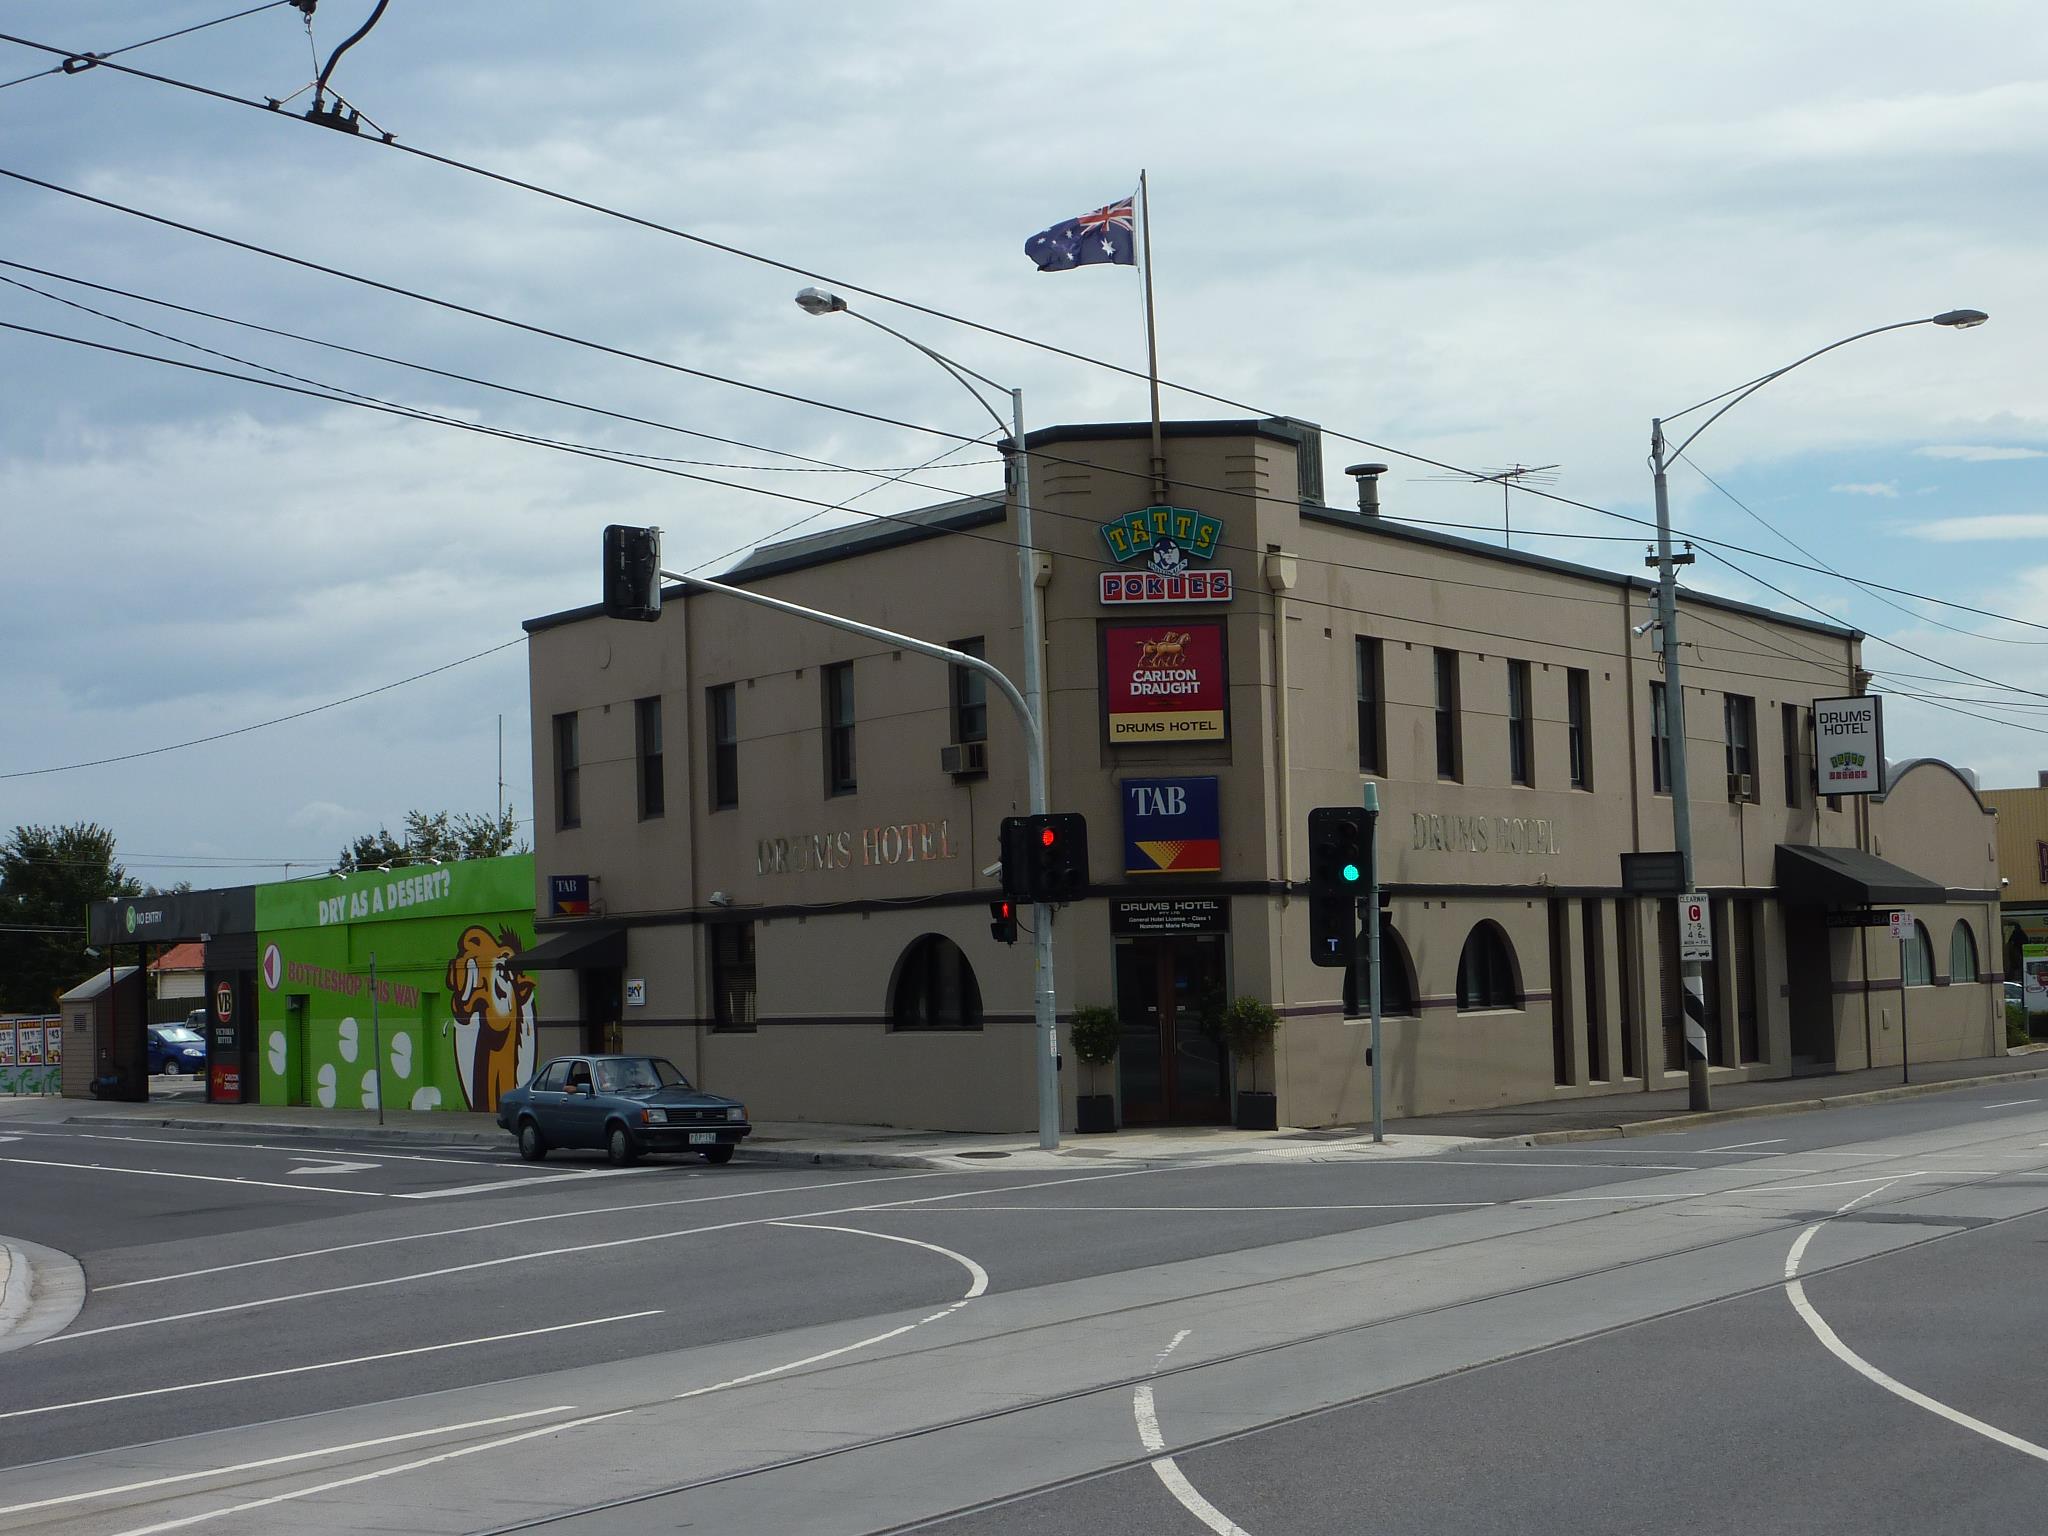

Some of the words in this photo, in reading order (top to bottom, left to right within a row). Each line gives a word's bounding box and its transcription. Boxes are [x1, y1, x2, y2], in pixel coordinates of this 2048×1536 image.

[1109, 512, 1213, 551] TATTS
[1105, 577, 1226, 596] POKIES
[1132, 669, 1197, 682] CARLTON
[1130, 681, 1200, 695] DRAUGHT
[1819, 710, 1872, 724] DRUMS
[1116, 722, 1165, 733] DRUMS
[1170, 721, 1217, 731] HOTEL
[1824, 722, 1868, 735] HOTEL
[1132, 786, 1187, 816] TAB
[1412, 812, 1489, 853] DRUMS
[1495, 817, 1560, 855] HOTEL
[757, 831, 853, 876] DRUMS
[863, 820, 959, 865] HOTEL
[556, 880, 577, 892] TAB
[319, 895, 346, 926] DRY
[350, 889, 369, 918] AS
[372, 887, 384, 913] A
[387, 869, 451, 910] DESERT?
[1120, 902, 1170, 911] DRUMS
[1175, 901, 1219, 910] HOTEL
[136, 913, 144, 925] NO
[145, 911, 163, 924] ENTRY
[1873, 914, 1890, 925] BA
[1327, 938, 1338, 951] T
[287, 960, 361, 998] BOTTLESHOP
[393, 983, 420, 1009] WAY
[627, 985, 642, 998] SKY
[218, 992, 231, 1012] VB
